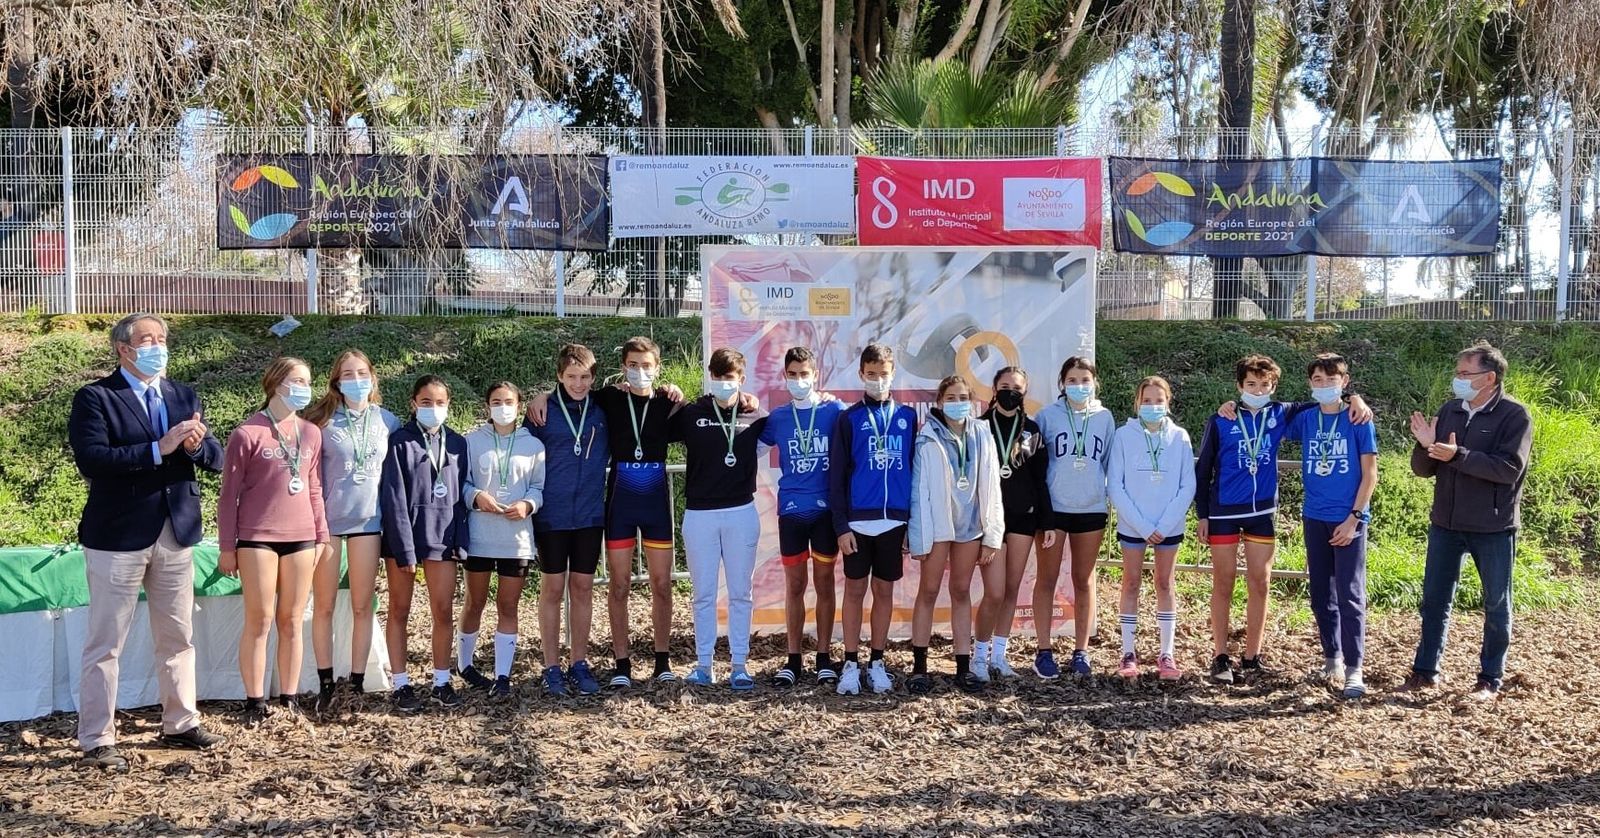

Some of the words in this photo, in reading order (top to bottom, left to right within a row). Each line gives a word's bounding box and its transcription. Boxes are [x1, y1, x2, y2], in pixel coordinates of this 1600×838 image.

[628, 161, 689, 169] @remoandaluz
[696, 162, 770, 183] FEDERACION
[923, 178, 975, 200] IMD
[696, 208, 744, 230] ANDALUZA
[746, 207, 771, 227] REMO
[908, 207, 946, 217] Instituto
[948, 210, 992, 222] Municipal
[308, 222, 364, 232] DEPORTE
[367, 222, 397, 233] 2021
[468, 219, 497, 228] Junta
[511, 217, 560, 229] Andalucía
[618, 222, 692, 230] www.remoandaluz.es
[788, 220, 849, 229] @remoandaluz
[922, 218, 935, 228] de
[937, 217, 979, 231] Deportes
[1205, 219, 1244, 231] Región
[1248, 219, 1295, 231] Europea
[1298, 218, 1316, 227] del
[1205, 232, 1261, 241] DEPORTE
[1264, 231, 1294, 241] 2021
[767, 287, 794, 299] IMD
